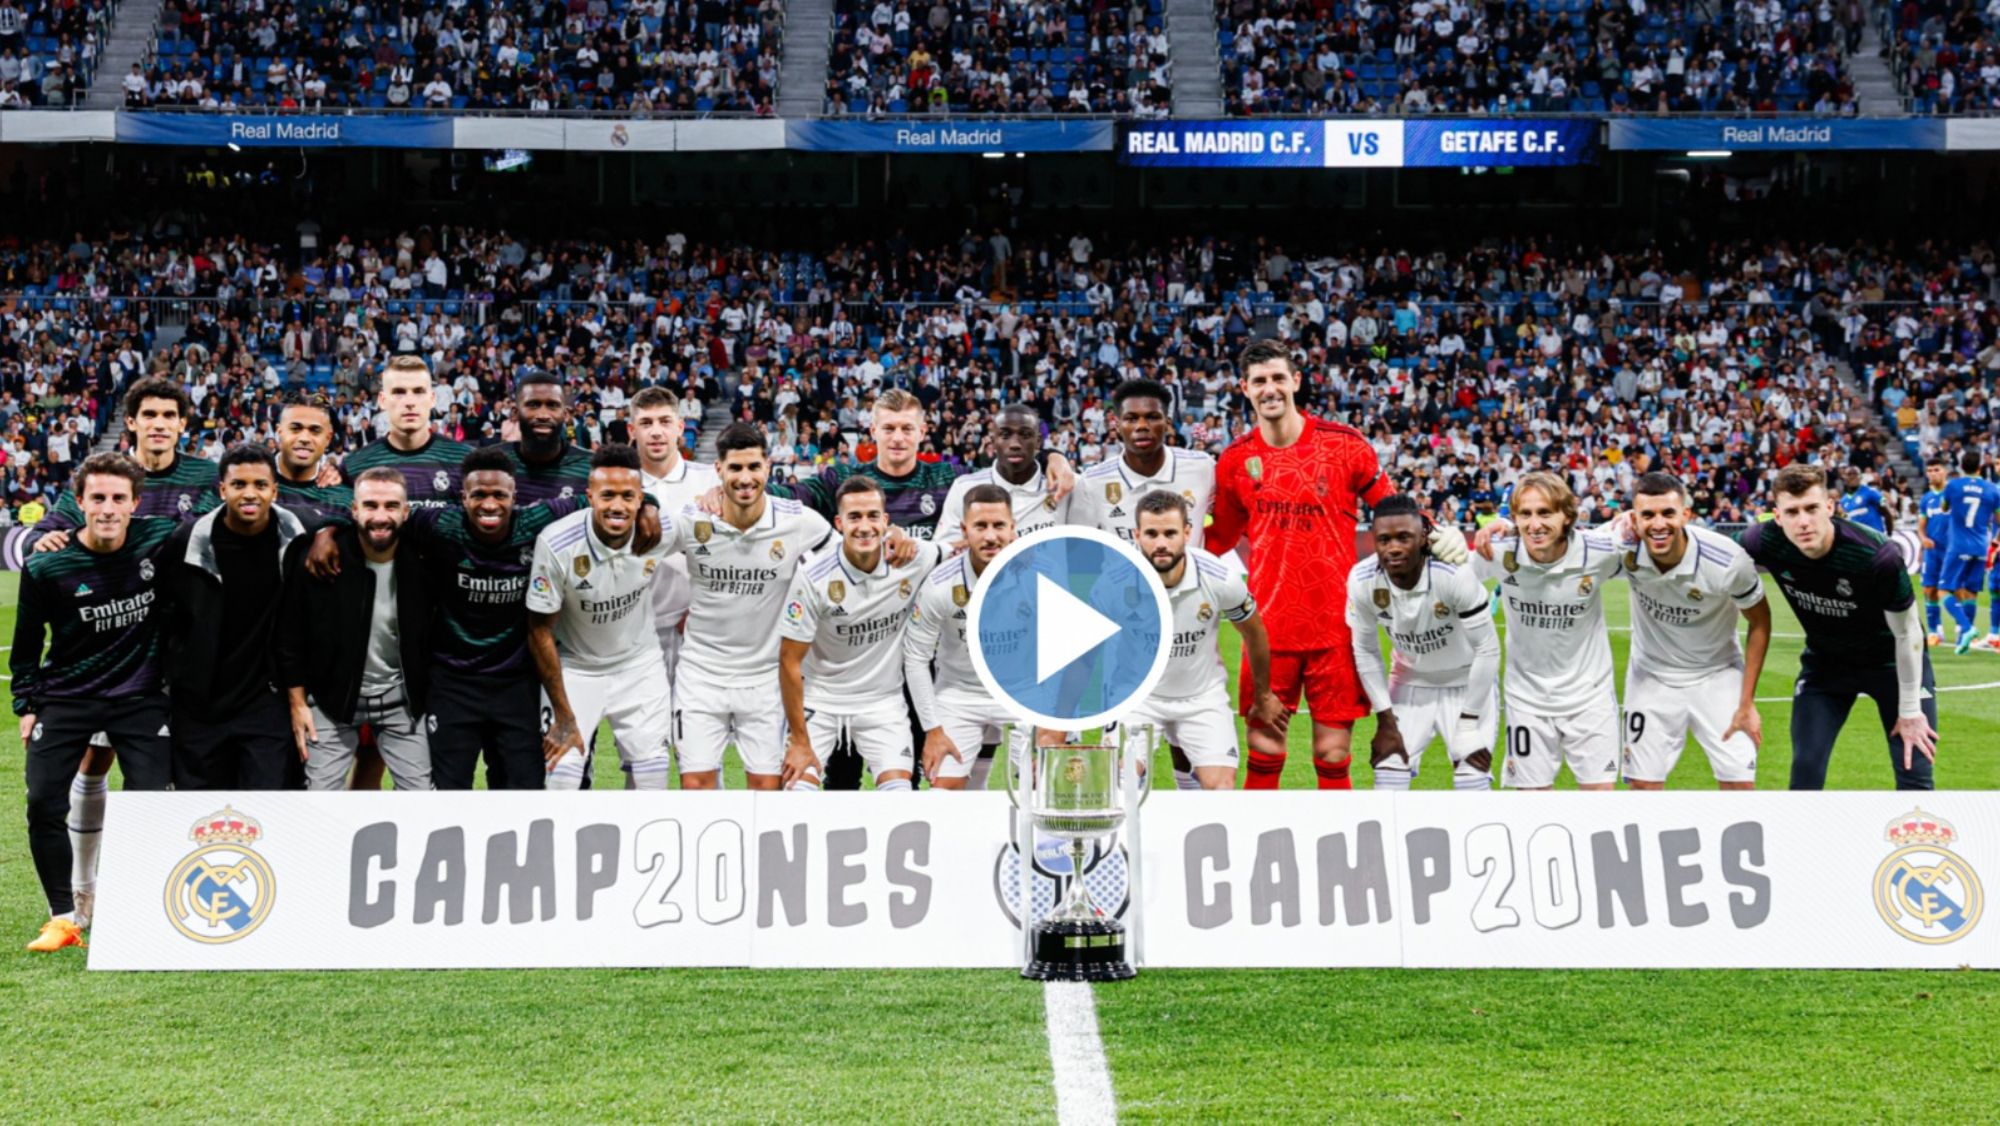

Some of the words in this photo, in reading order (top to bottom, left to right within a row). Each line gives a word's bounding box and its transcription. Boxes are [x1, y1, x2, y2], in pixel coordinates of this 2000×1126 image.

[232, 121, 270, 139] Real
[276, 121, 339, 139] Madrid
[897, 128, 934, 145] Real
[941, 128, 1001, 145] Madrid
[1724, 126, 1763, 143] Real
[1769, 126, 1830, 143] Madrid
[1128, 131, 1179, 154] REAL
[1184, 131, 1265, 154] MADRID
[1271, 131, 1311, 154] C.F.
[1348, 132, 1379, 155] VS
[1440, 130, 1518, 154] GETAFE
[1522, 130, 1566, 154] C.F.
[1963, 496, 1981, 528] 7
[698, 563, 778, 581] Emirates
[457, 572, 527, 592] Emirate
[728, 581, 765, 595] BETTER
[79, 588, 155, 622] Emirates
[1509, 596, 1586, 617] Emirates
[96, 617, 112, 633] FLY
[1520, 614, 1536, 627] FLY
[1539, 617, 1574, 631] BETTER
[848, 634, 865, 647] FLY
[1414, 637, 1448, 655] BETTER
[1624, 710, 1646, 744] 19
[1506, 724, 1531, 758] 10
